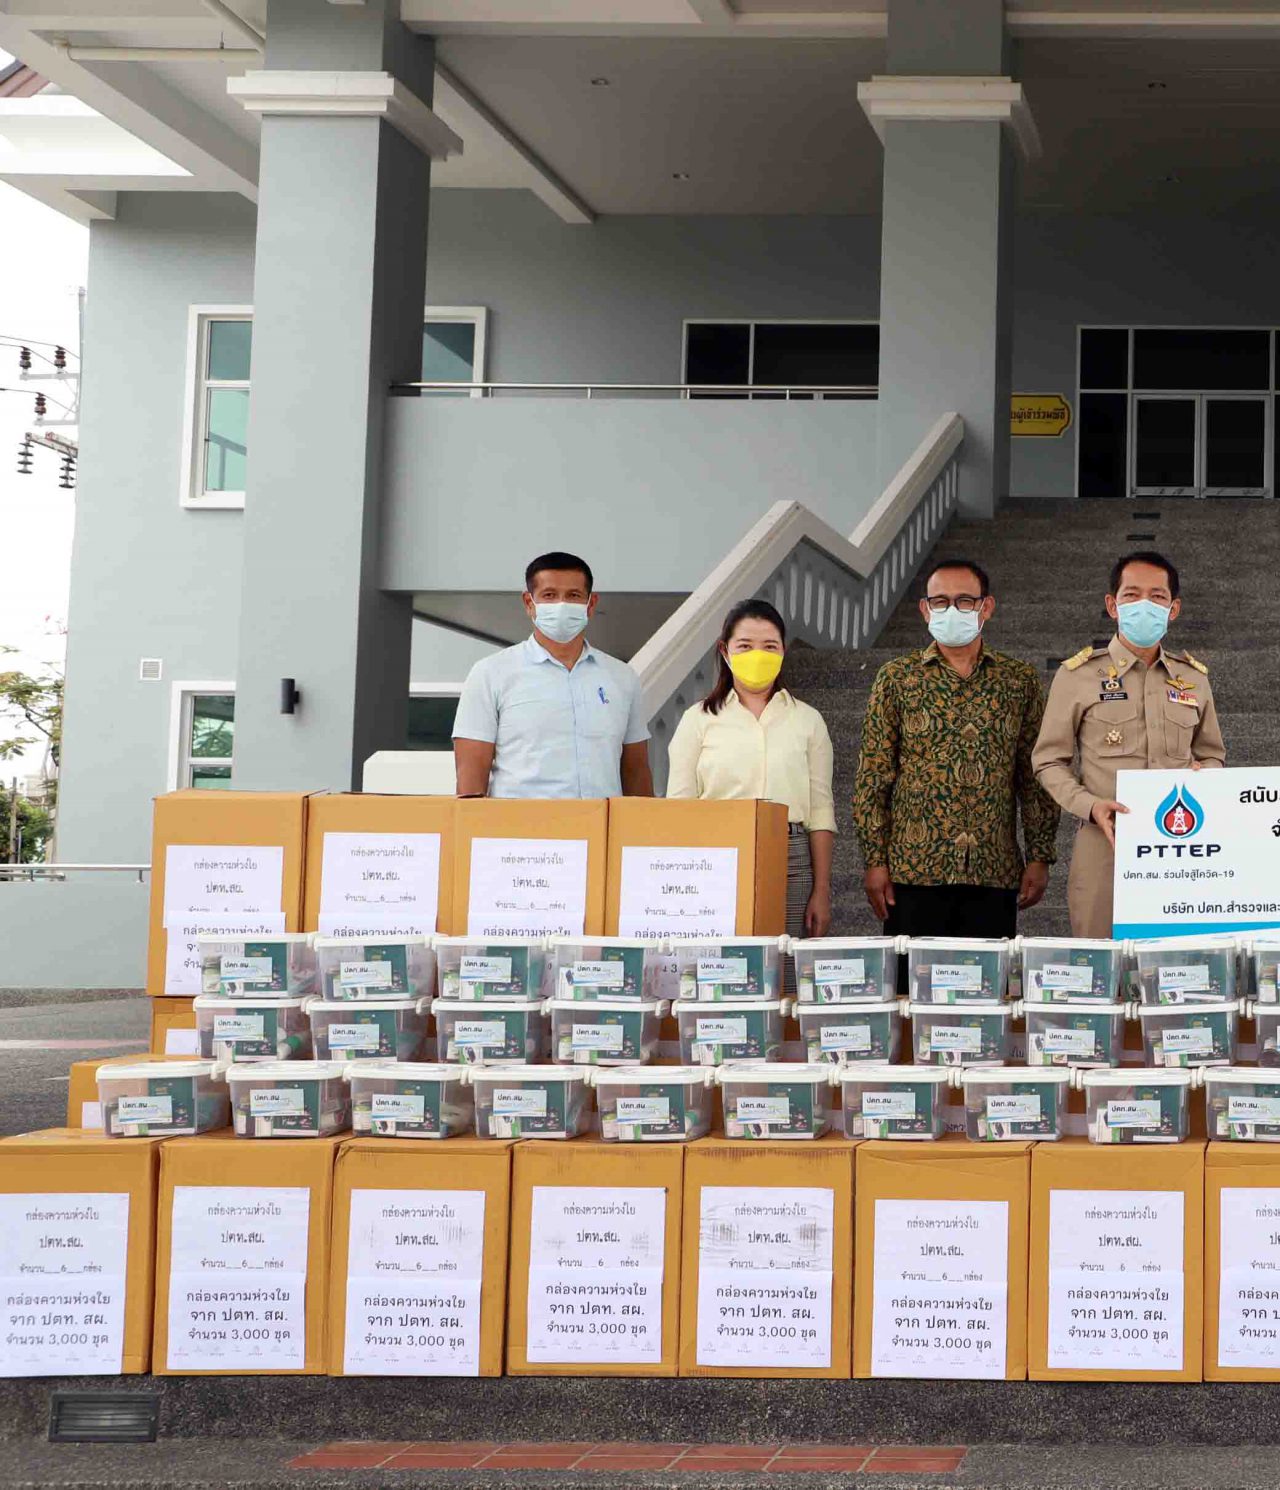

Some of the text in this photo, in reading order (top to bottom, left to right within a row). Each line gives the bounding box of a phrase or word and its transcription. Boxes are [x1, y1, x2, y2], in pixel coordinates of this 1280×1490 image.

[1136, 843, 1222, 859] PTTEP
[1162, 901, 1195, 915] บริษัท
[186, 1287, 290, 1302] กล่องความห่วงใย
[545, 1281, 647, 1296] กล่องความห่วงใย
[716, 1284, 818, 1300] กล่องความห่วงใย
[1067, 1285, 1169, 1302] กล่องความห่วงใย
[7, 1290, 111, 1306] กล่องความห่วงใย
[364, 1293, 466, 1309] กล่องความห่วงใย
[890, 1294, 993, 1311] กล่องความห่วงใย
[190, 1307, 289, 1322] จาก ปตท. สผ.
[549, 1300, 645, 1316] จาก ปตท. สผ.
[719, 1303, 816, 1320] จาก ปตท. สผ.
[1070, 1305, 1167, 1322] จาก ปตท. สผ.
[1241, 1308, 1268, 1320] จาก
[9, 1311, 108, 1326] จาก ปตท. สผ.
[367, 1313, 464, 1329] จาก ปตท. สผ.
[894, 1314, 991, 1331] จาก ปตท. สผ.
[188, 1327, 227, 1341] จำนวน
[274, 1330, 291, 1344] ชุด
[546, 1319, 585, 1334] จำนวน
[630, 1324, 647, 1339] ชุด
[716, 1323, 754, 1337] จำนวน
[800, 1328, 817, 1343] ชุด
[1068, 1324, 1107, 1339] จำนวน
[1152, 1330, 1169, 1345] ชุด
[1238, 1324, 1277, 1339] จำนวน
[6, 1332, 44, 1346] จำนวน
[92, 1334, 109, 1348] ชุด
[364, 1332, 403, 1346] จำนวน
[448, 1337, 465, 1352] ชุด
[891, 1334, 930, 1348] จำนวน
[975, 1339, 992, 1353] ชุด
